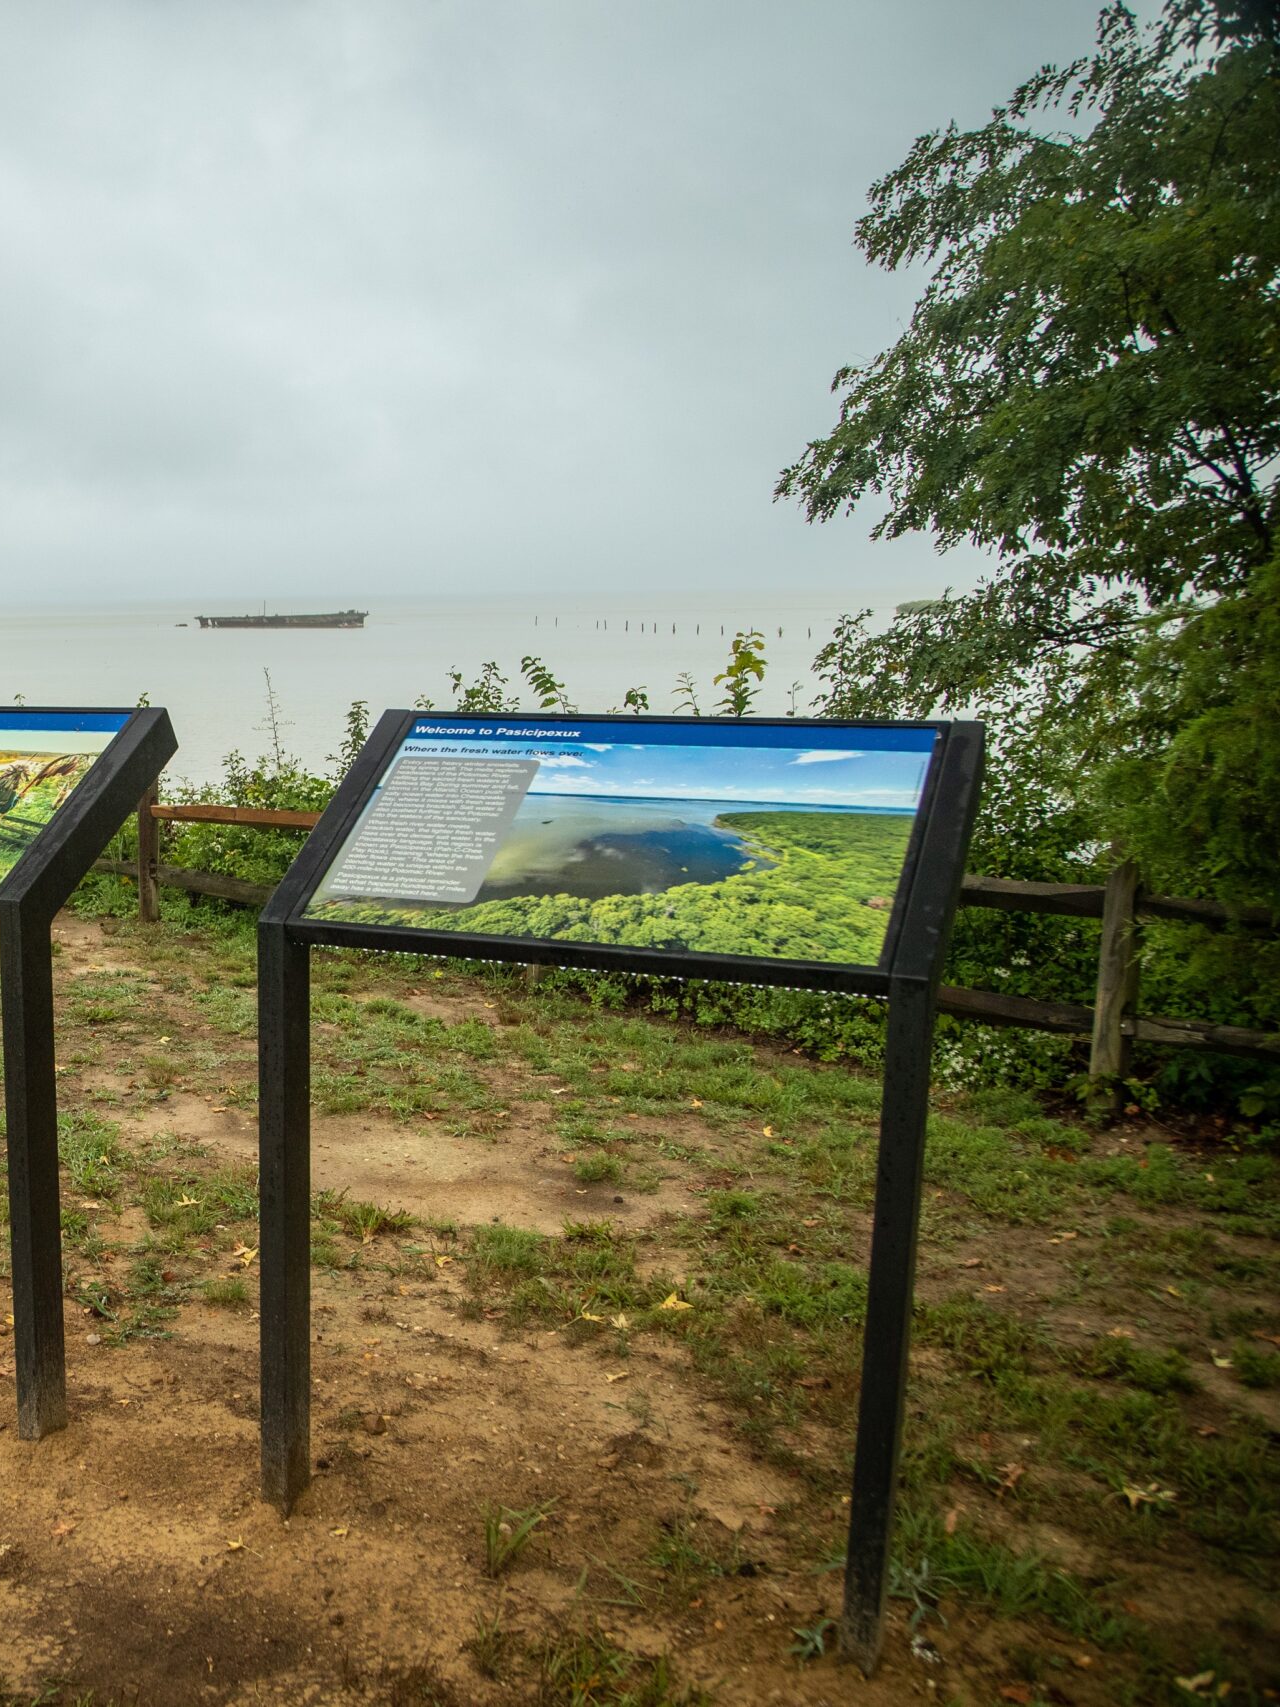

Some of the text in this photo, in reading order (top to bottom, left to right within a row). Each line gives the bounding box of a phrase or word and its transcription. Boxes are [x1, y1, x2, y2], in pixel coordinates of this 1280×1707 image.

[415, 725, 582, 738] Welcome to Pasicipexux
